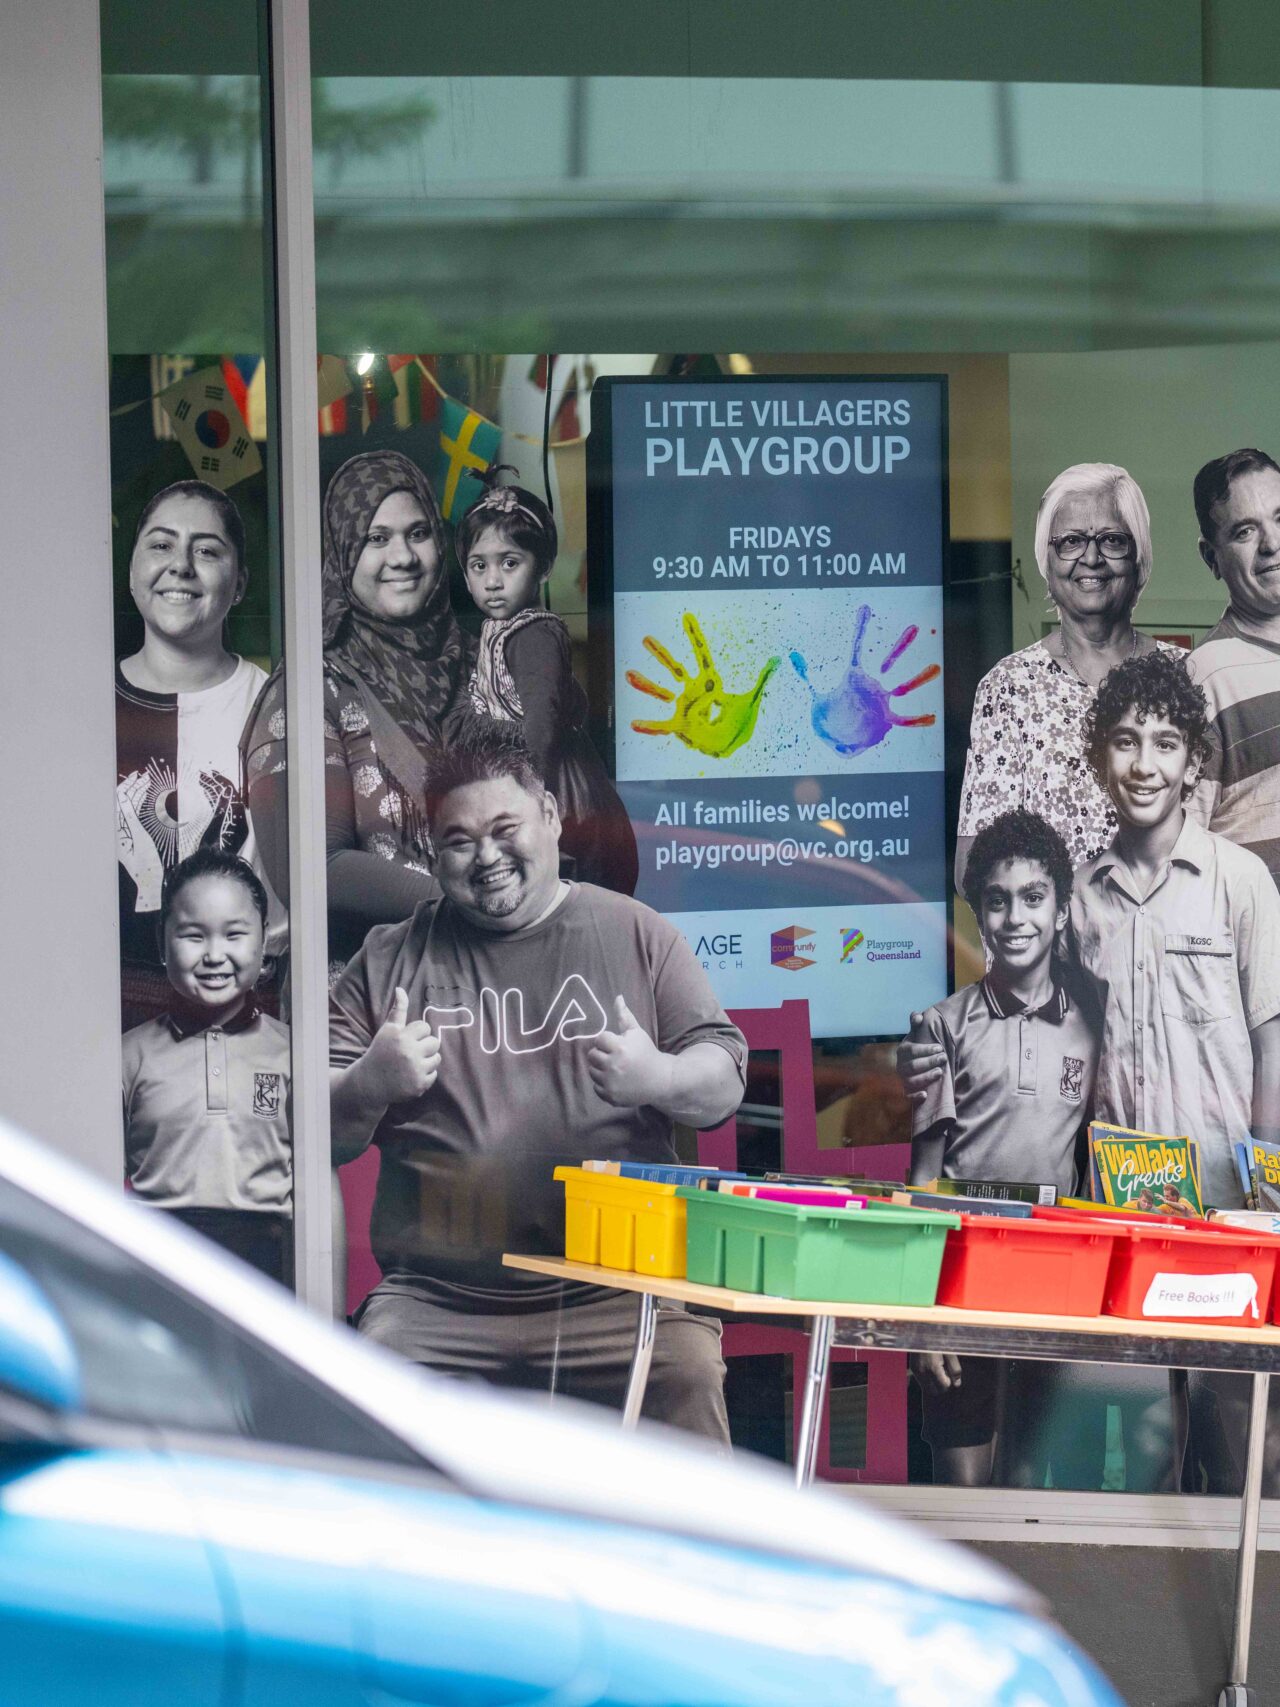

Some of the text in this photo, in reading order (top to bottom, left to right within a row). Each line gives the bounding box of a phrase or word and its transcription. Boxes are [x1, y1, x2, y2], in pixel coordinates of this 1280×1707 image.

[645, 399, 911, 428] LITTLE VILLAGERS
[645, 435, 911, 477] PLAYGROUP
[729, 525, 832, 549] FRIDAYS
[652, 552, 906, 579] 9:30 AM TO 11:00 AM
[654, 795, 910, 827] All families welcome!
[655, 836, 910, 870] playgroup@vc.org.au
[866, 939, 914, 951] Playgroup
[866, 950, 921, 961] Queensland
[1190, 936, 1212, 946] KGSC
[423, 973, 608, 1055] FILA
[1104, 1143, 1187, 1179] Wallaby
[1117, 1159, 1184, 1202] Greats
[1158, 1288, 1185, 1302] Free
[1187, 1290, 1220, 1303] Books
